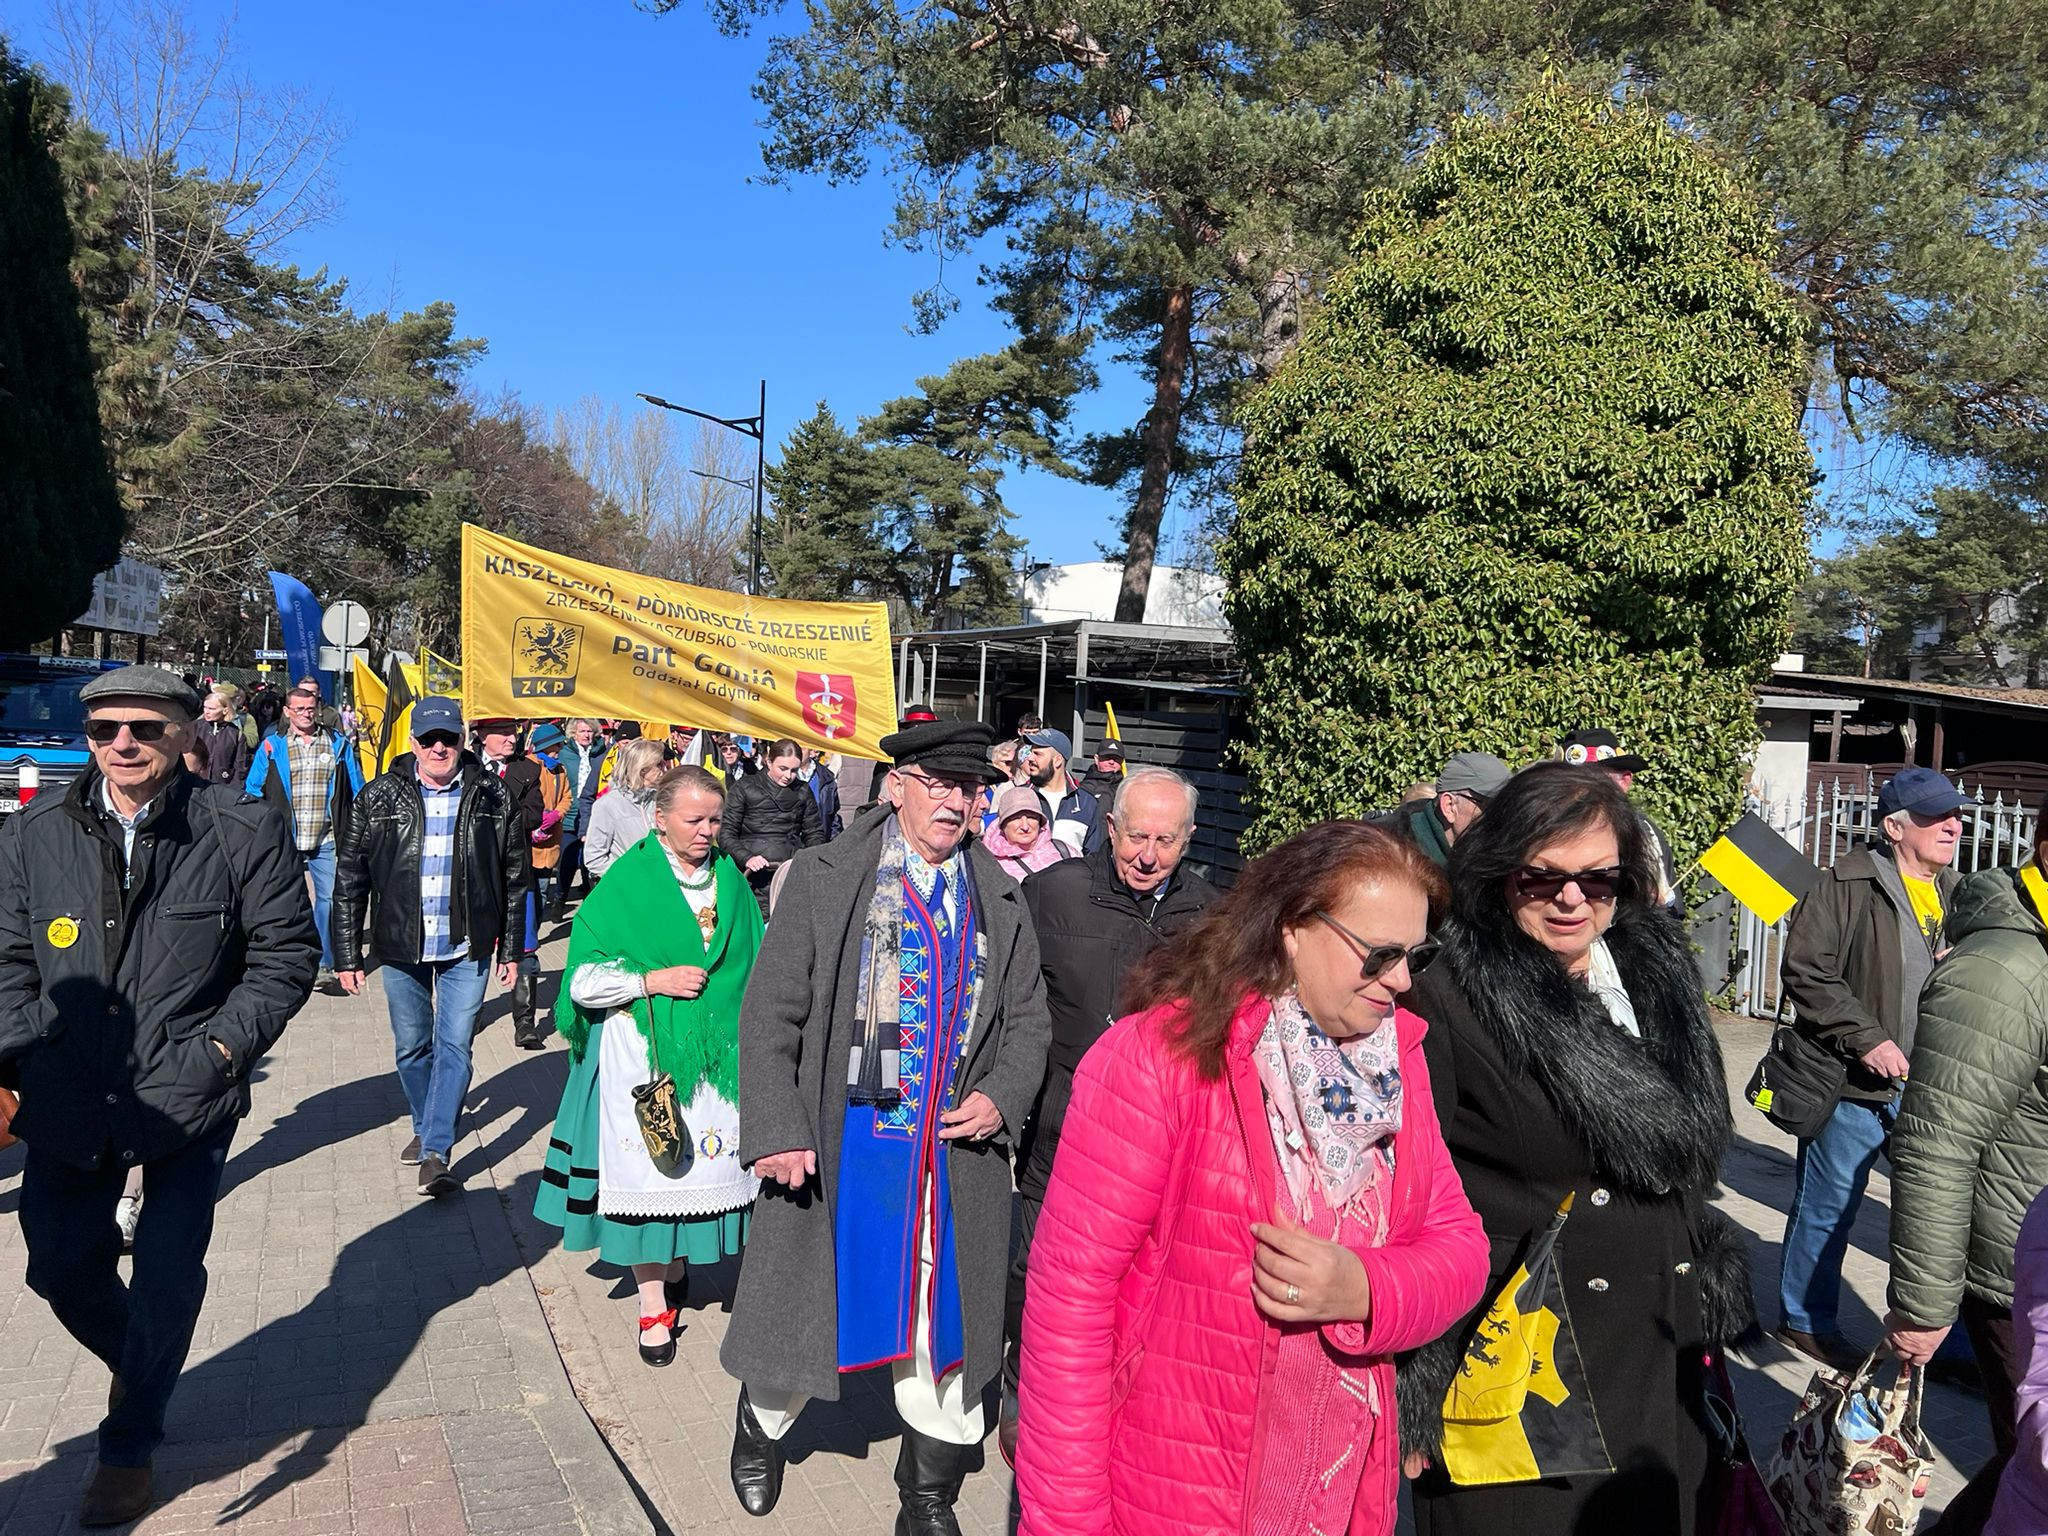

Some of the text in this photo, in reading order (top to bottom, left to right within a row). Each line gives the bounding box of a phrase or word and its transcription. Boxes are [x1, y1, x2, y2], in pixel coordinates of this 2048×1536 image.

[546, 591, 648, 624] ZRZESZEN
[650, 621, 737, 648] ASZUBSKO
[748, 640, 828, 661] POMORSKIE
[758, 619, 873, 641] ZRZESZENIÉ
[612, 635, 677, 668] Part
[521, 680, 564, 694] ZKP
[632, 665, 761, 702] Oddział Gdynia
